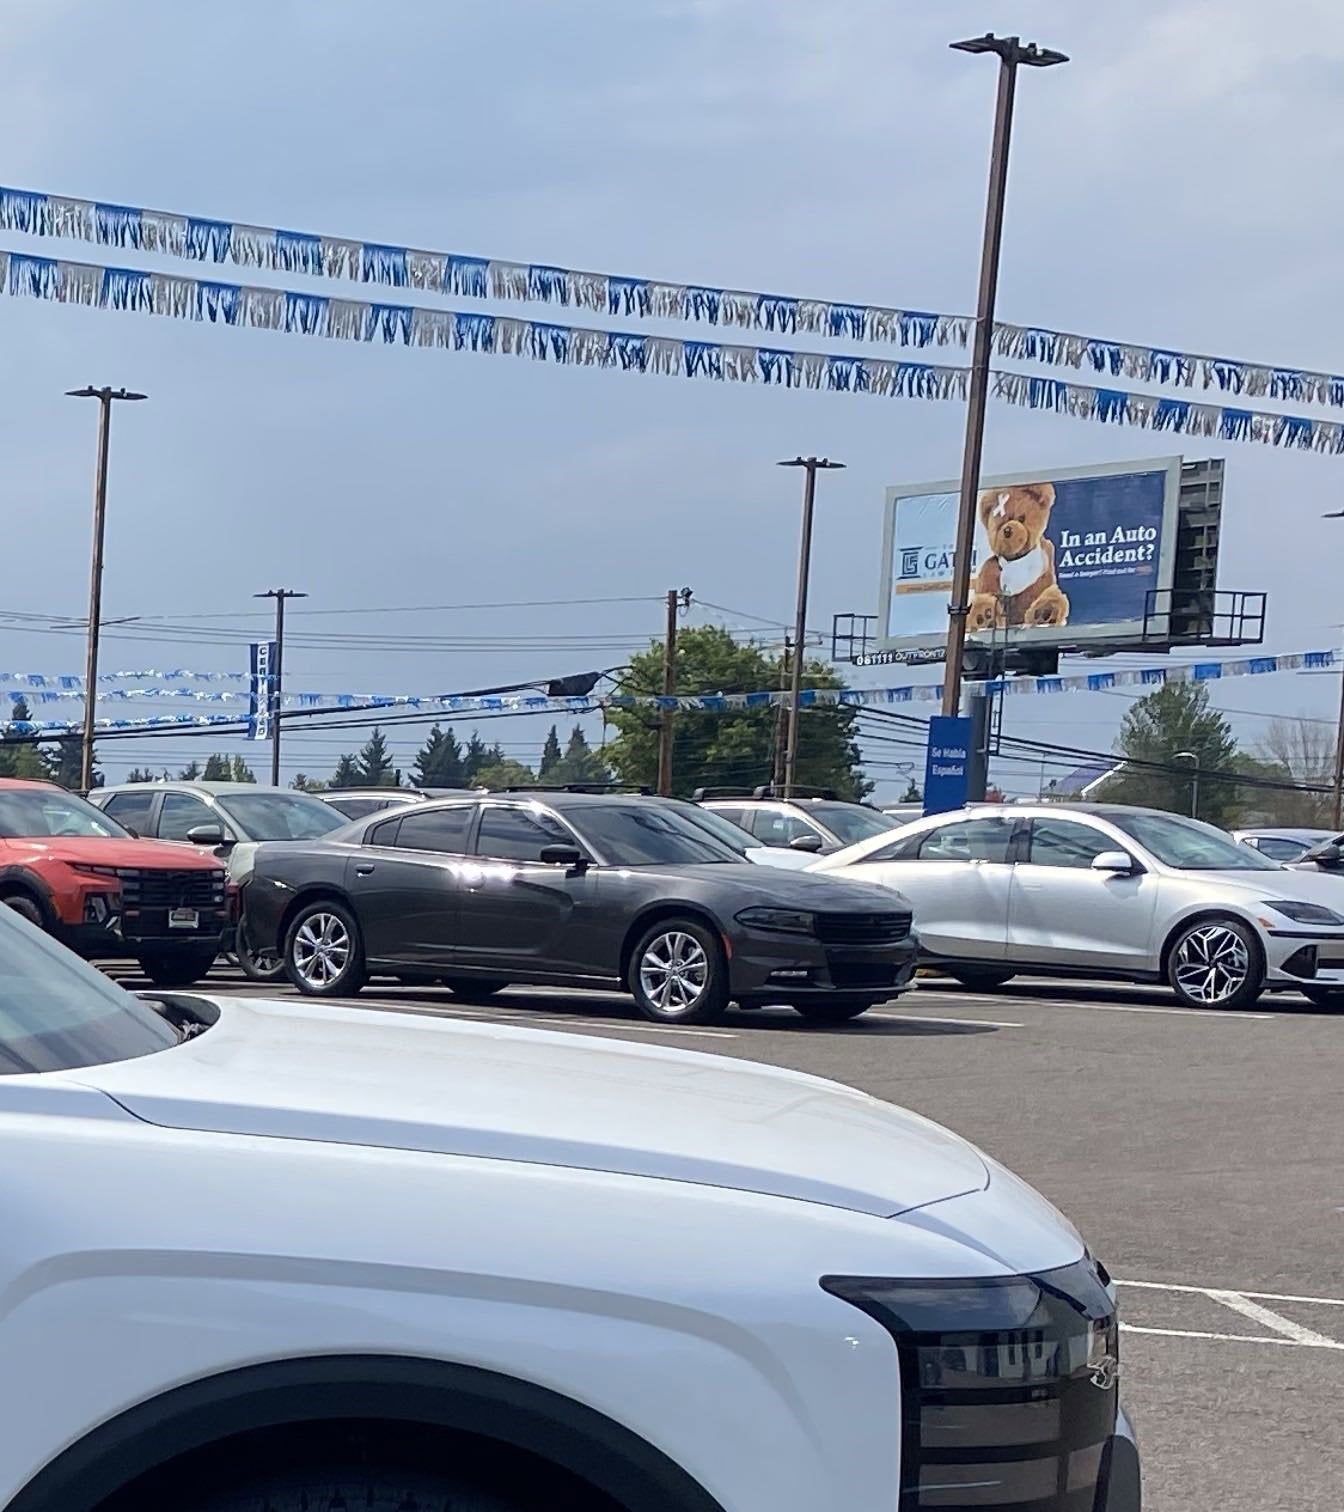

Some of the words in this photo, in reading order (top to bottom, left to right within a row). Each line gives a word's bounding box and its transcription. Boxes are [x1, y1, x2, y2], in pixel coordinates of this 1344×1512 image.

[1060, 530, 1081, 548] In
[1084, 532, 1107, 546] an
[1111, 526, 1157, 545] Auto
[1059, 544, 1155, 567] Accident?
[932, 747, 941, 758] Se
[943, 747, 967, 759] Habla
